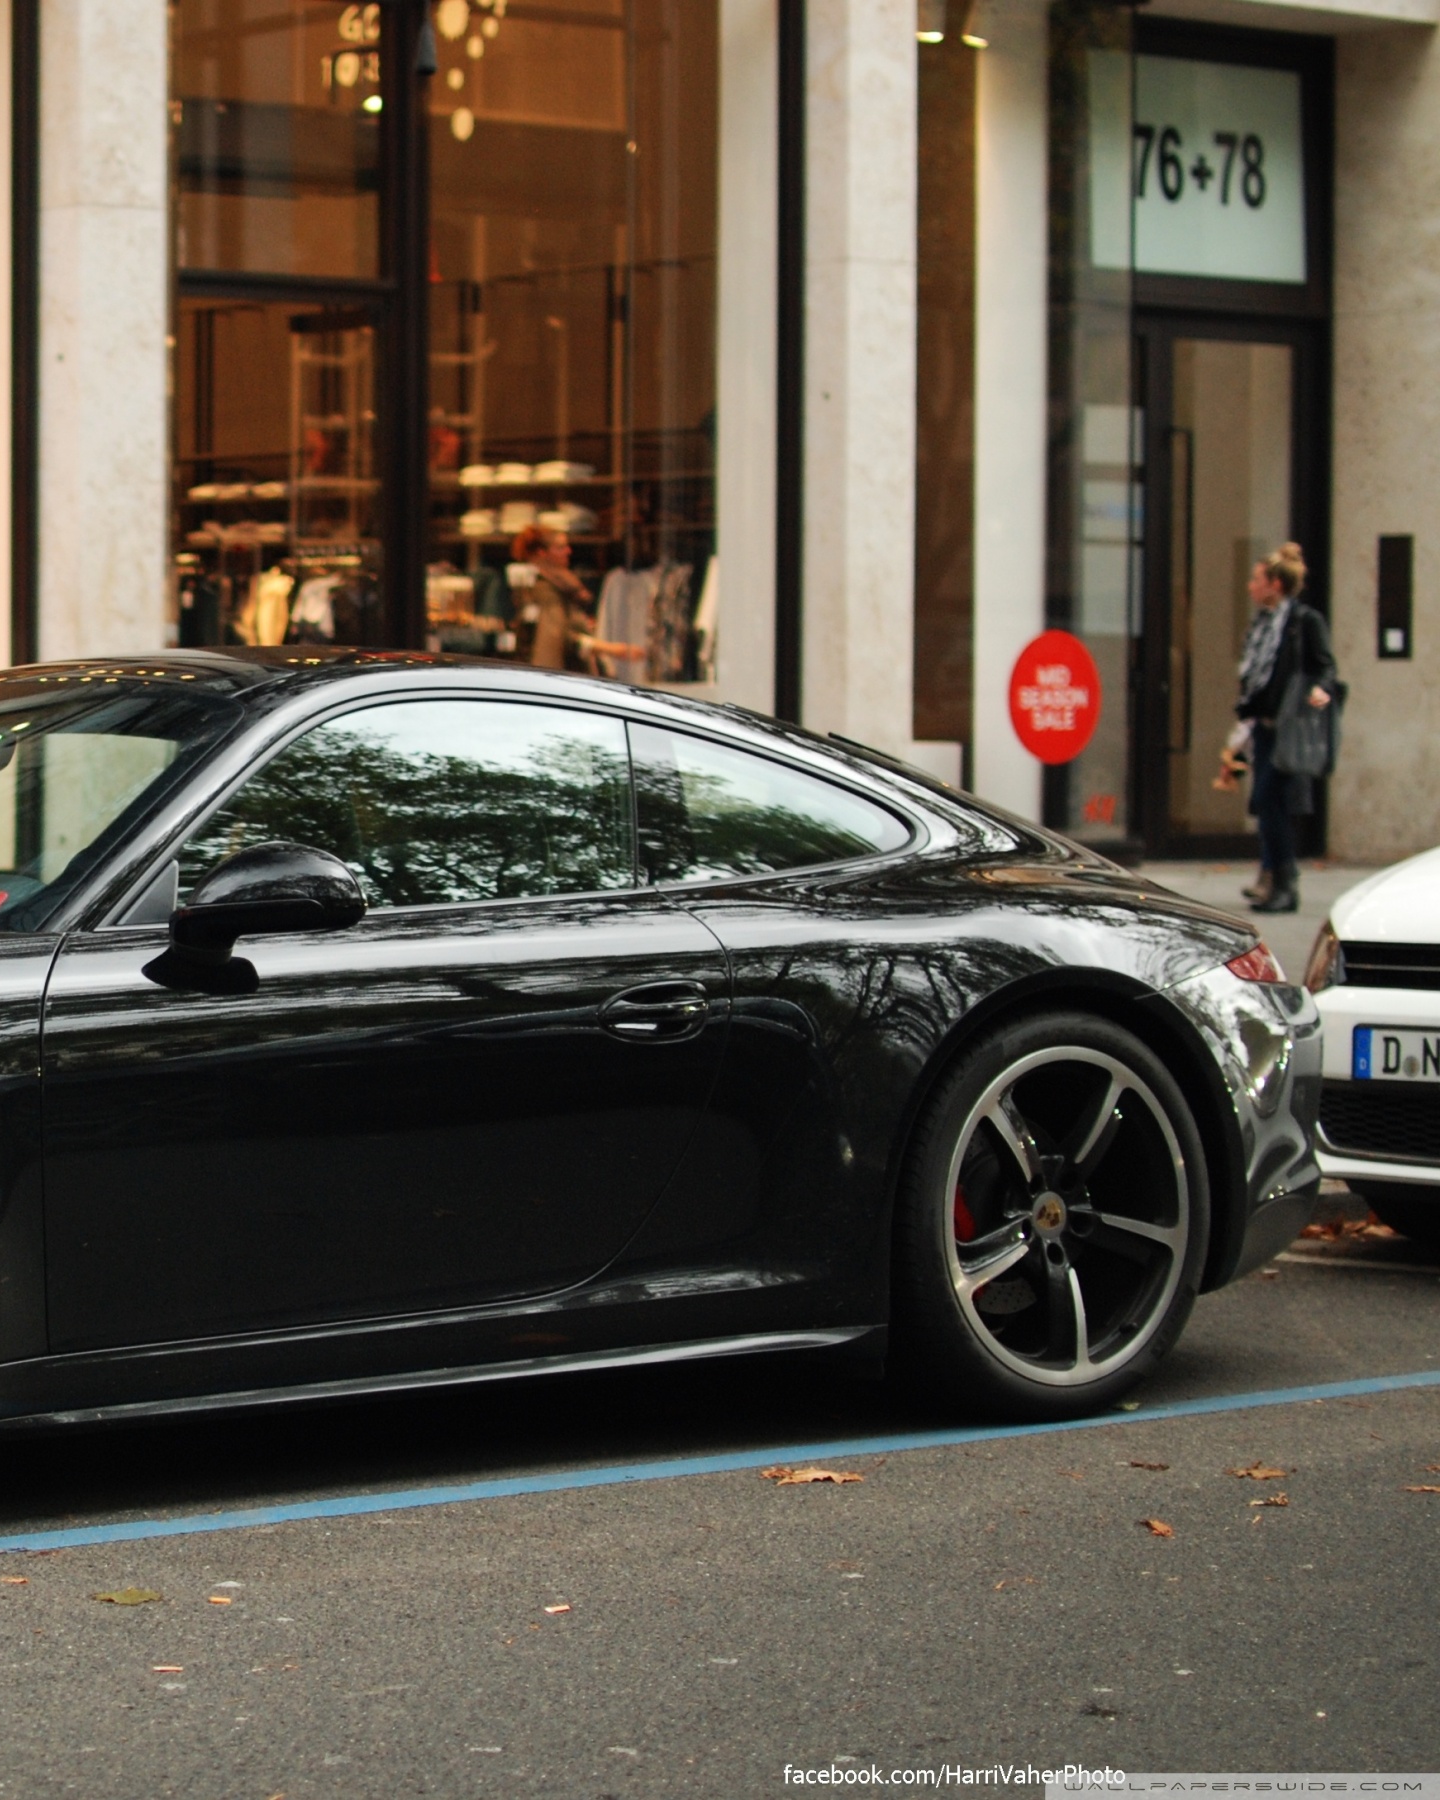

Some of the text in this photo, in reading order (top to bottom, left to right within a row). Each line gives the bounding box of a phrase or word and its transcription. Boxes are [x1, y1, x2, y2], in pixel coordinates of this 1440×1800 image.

[1133, 123, 1266, 209] 76+78
[1037, 664, 1072, 686] MID
[1018, 686, 1089, 710] SEASON
[1032, 707, 1076, 731] SALE
[1382, 1036, 1401, 1075] D
